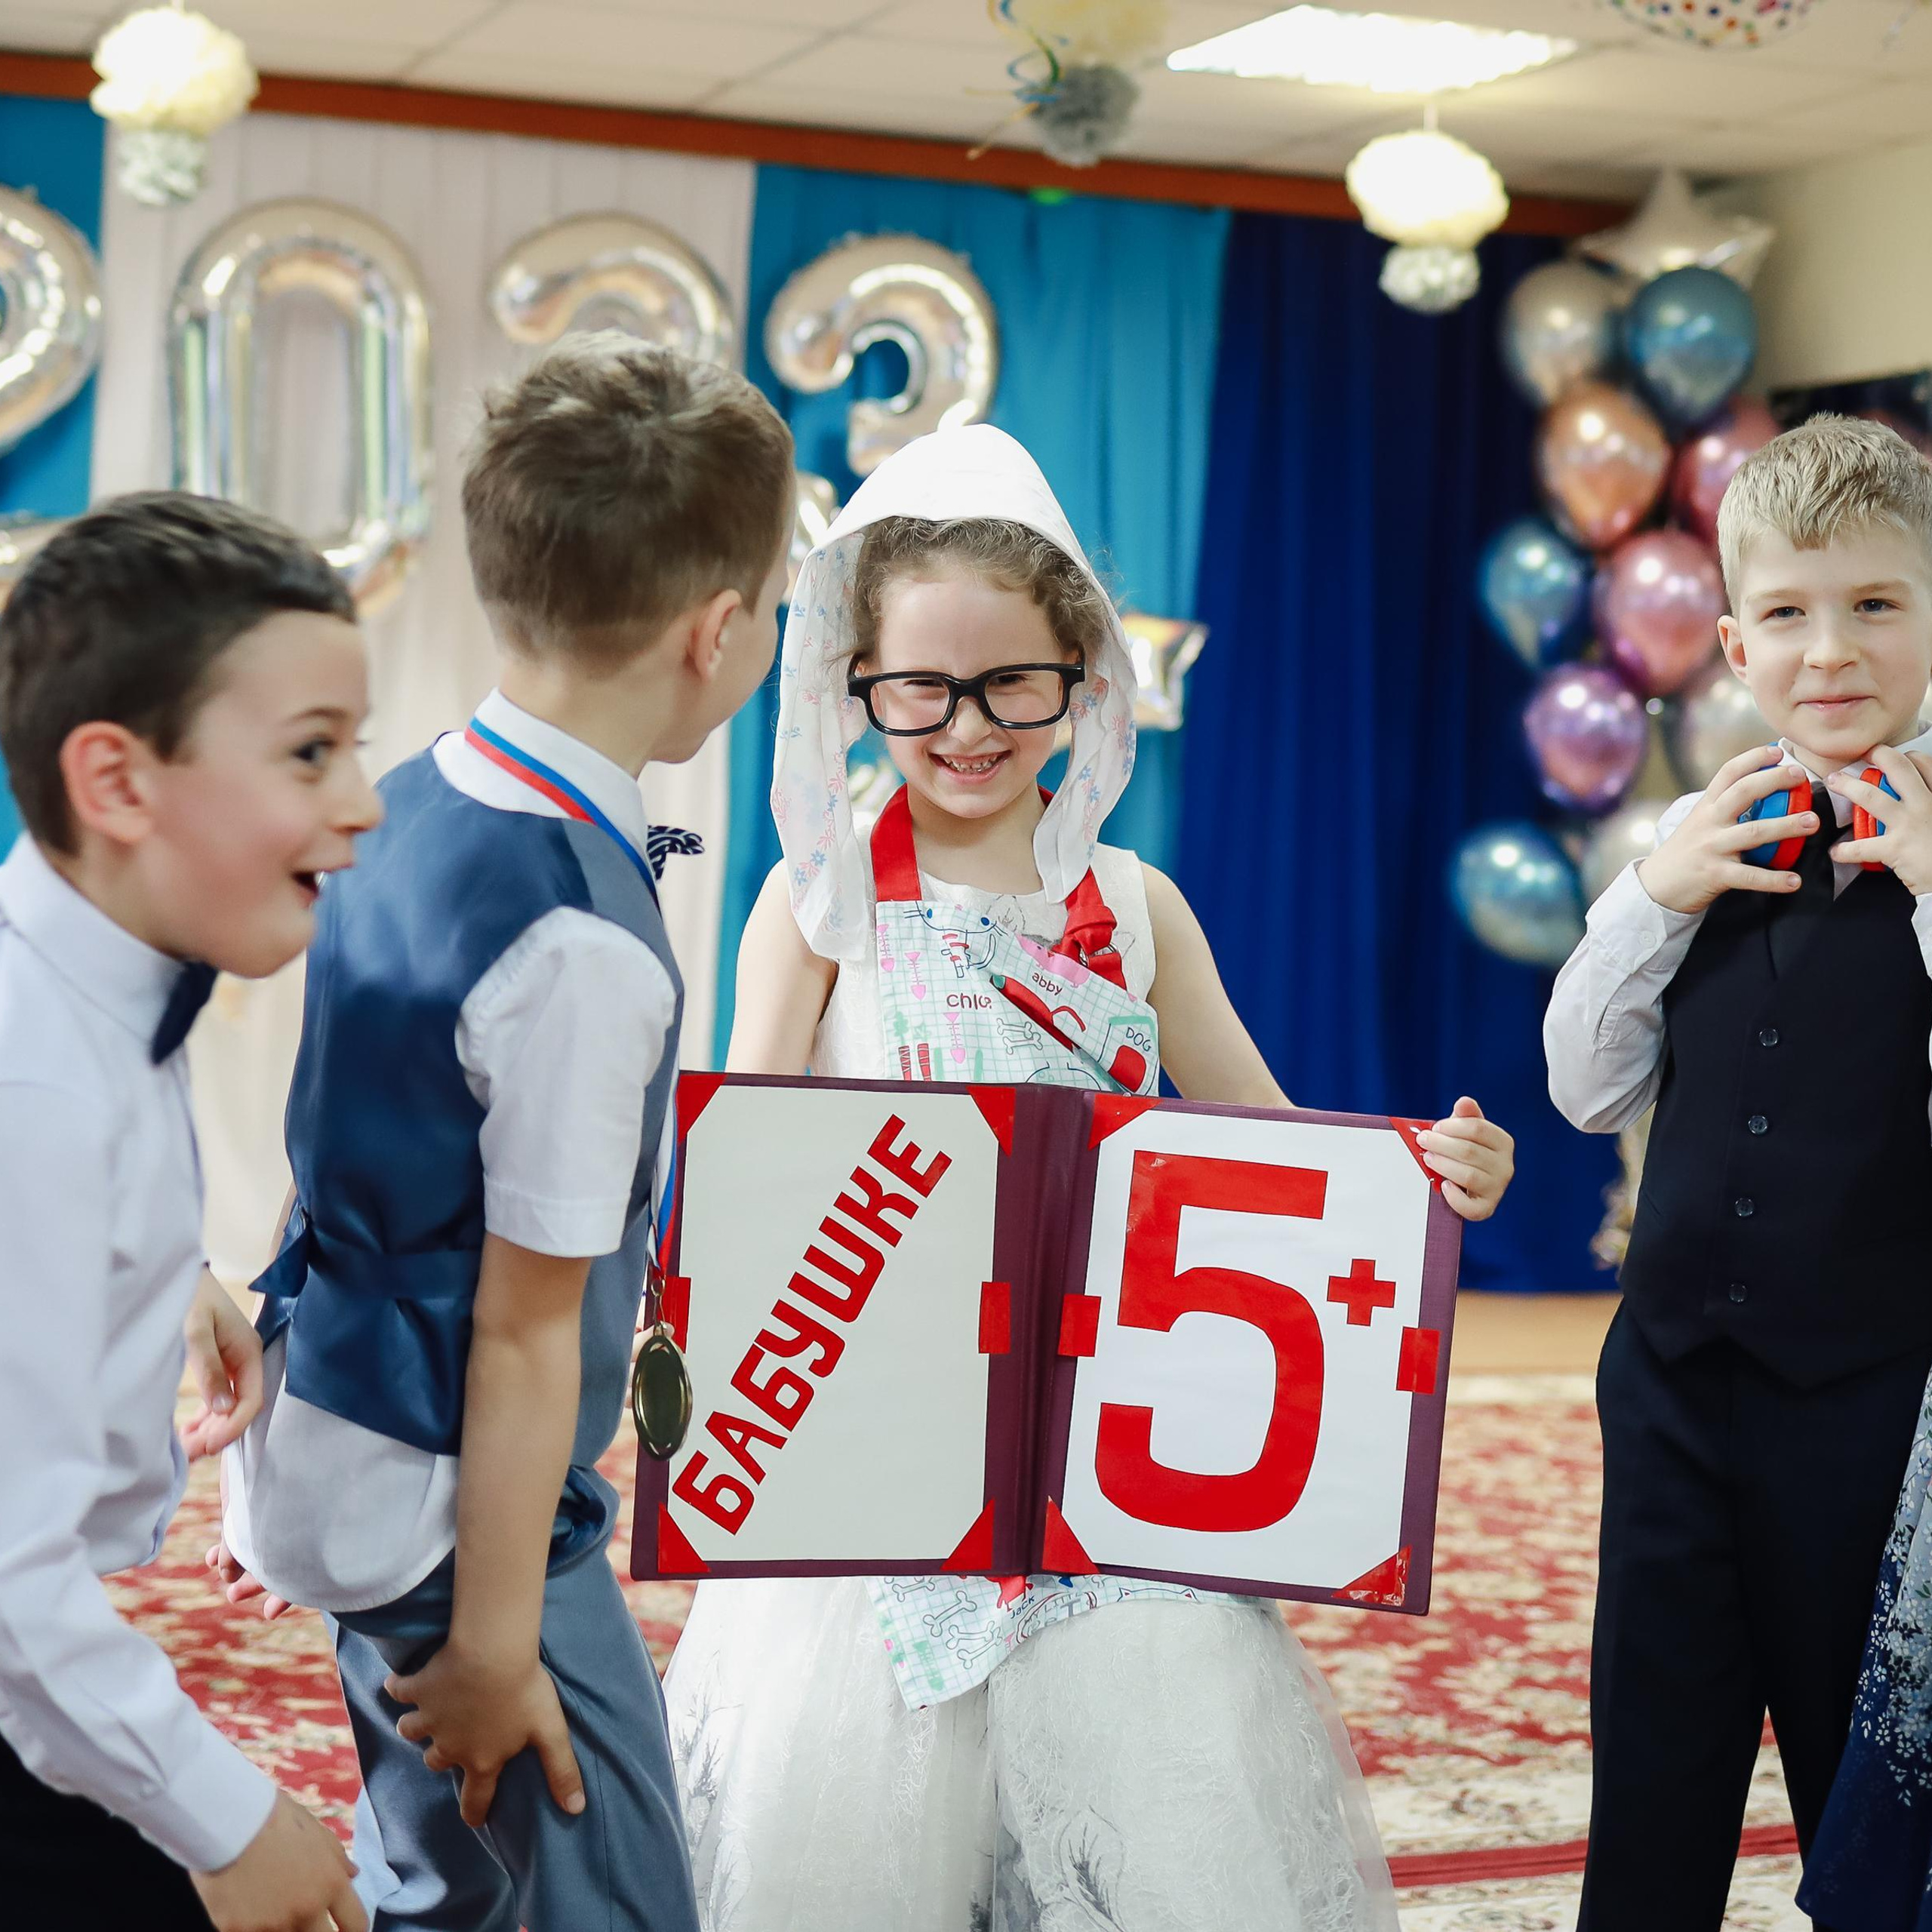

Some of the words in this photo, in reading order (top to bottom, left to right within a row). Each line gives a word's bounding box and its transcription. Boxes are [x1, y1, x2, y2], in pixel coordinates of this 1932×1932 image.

[1032, 972, 1063, 996] abby
[1125, 1026, 1152, 1052] DOG
[672, 1114, 952, 1535] БАБУШКЕ
